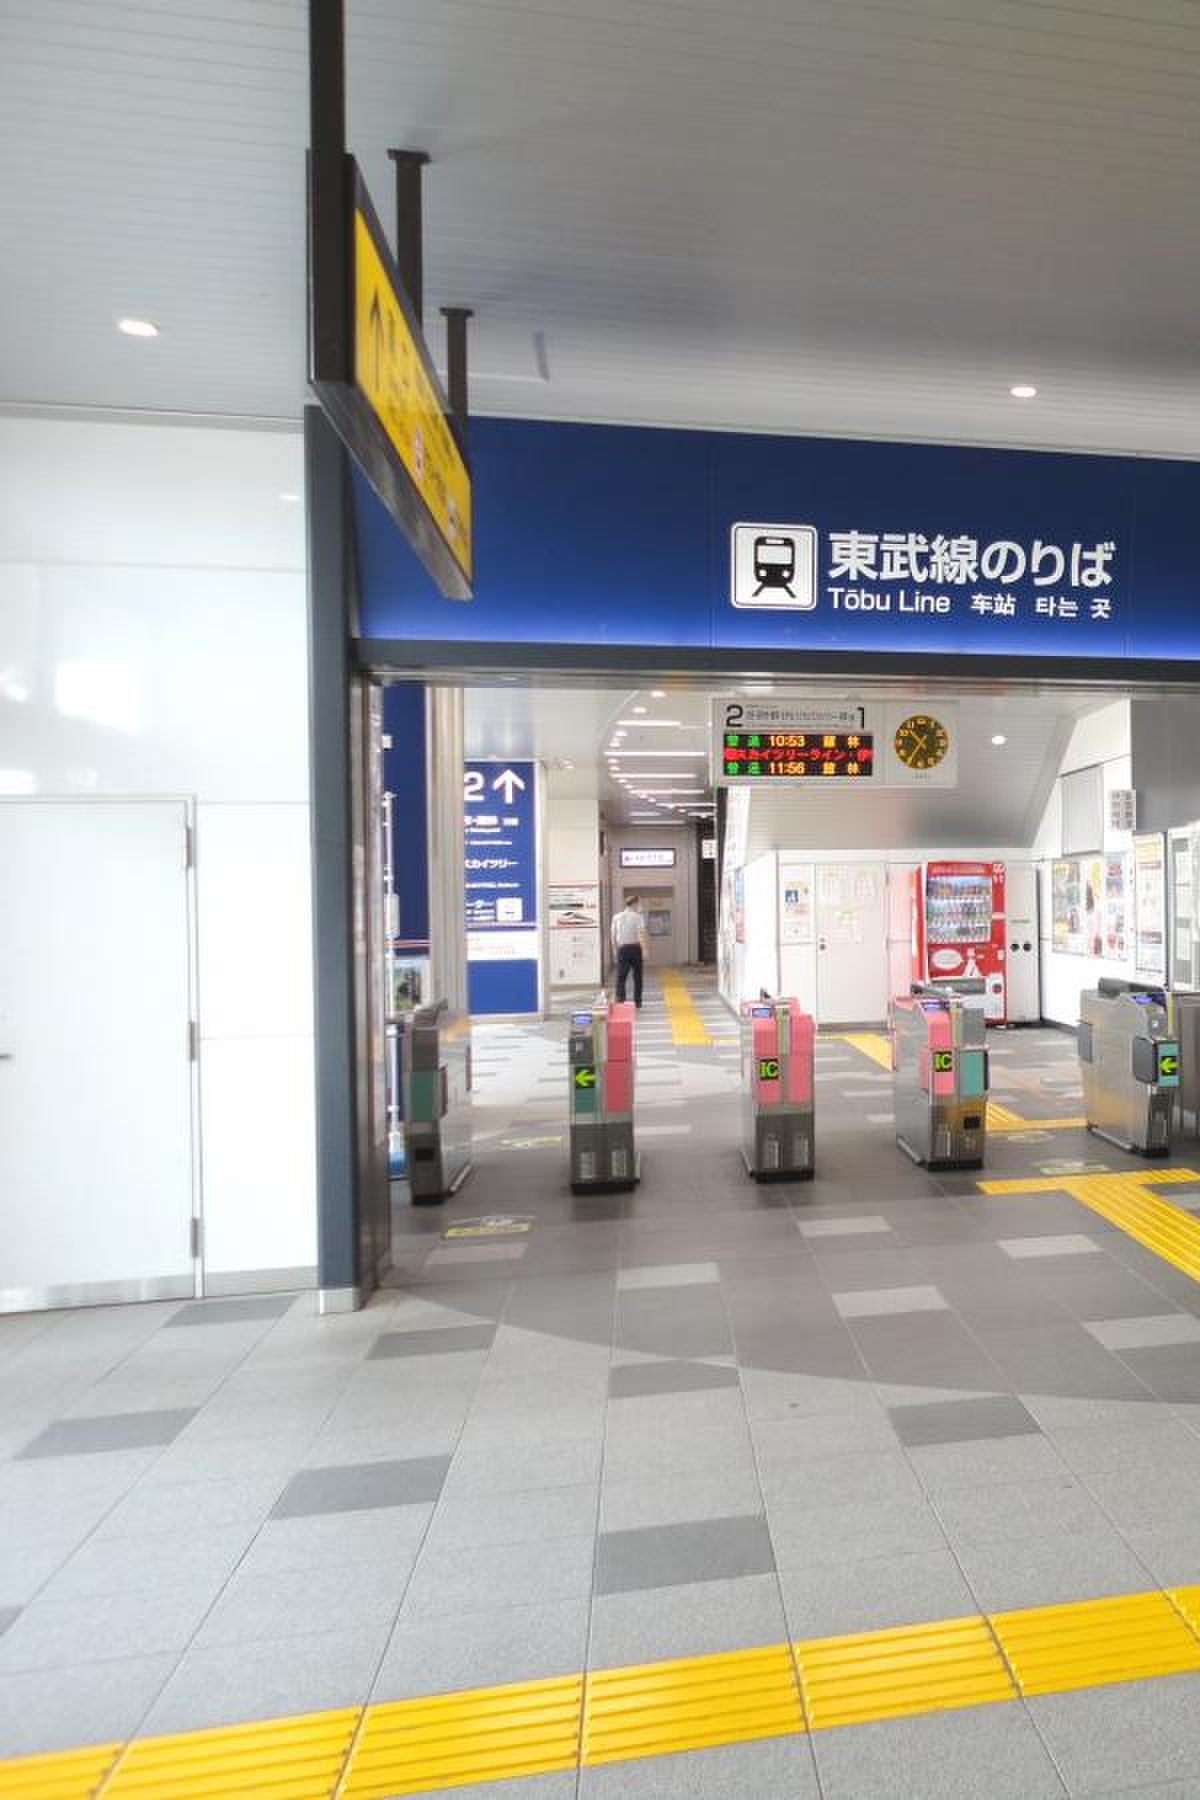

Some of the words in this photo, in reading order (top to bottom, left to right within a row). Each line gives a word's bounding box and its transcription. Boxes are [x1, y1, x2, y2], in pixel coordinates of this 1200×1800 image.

[828, 530, 1116, 588] 東武線のりば
[827, 586, 891, 612] Tōbu
[899, 589, 951, 614] Line
[970, 593, 1017, 617] 车站
[1034, 596, 1080, 619] 타는
[1090, 598, 1112, 620] 곳
[726, 704, 744, 728] 2
[857, 706, 865, 729] 1
[770, 735, 805, 747] 10:53
[464, 771, 485, 801] 2
[758, 1060, 778, 1079] IC
[934, 1052, 953, 1071] IC
